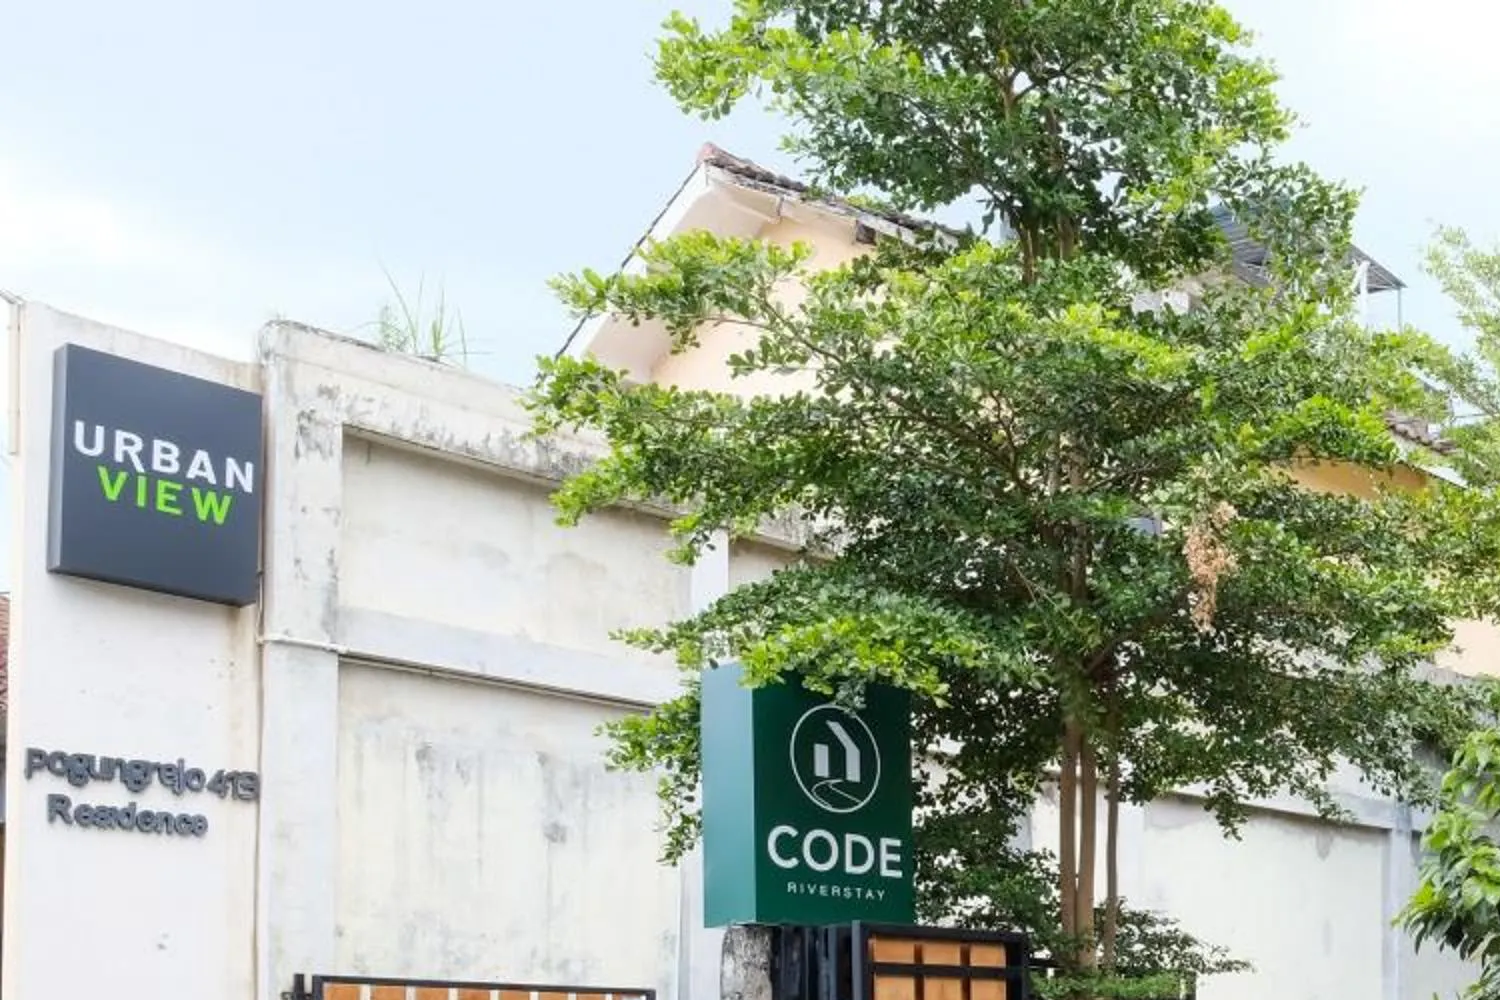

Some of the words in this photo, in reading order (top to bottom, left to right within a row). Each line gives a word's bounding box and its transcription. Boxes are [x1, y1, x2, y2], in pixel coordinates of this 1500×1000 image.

[74, 419, 255, 494] URBAN
[97, 465, 233, 525] VIEW
[767, 825, 903, 878] CODE
[786, 881, 886, 901] RIVERSTAY
